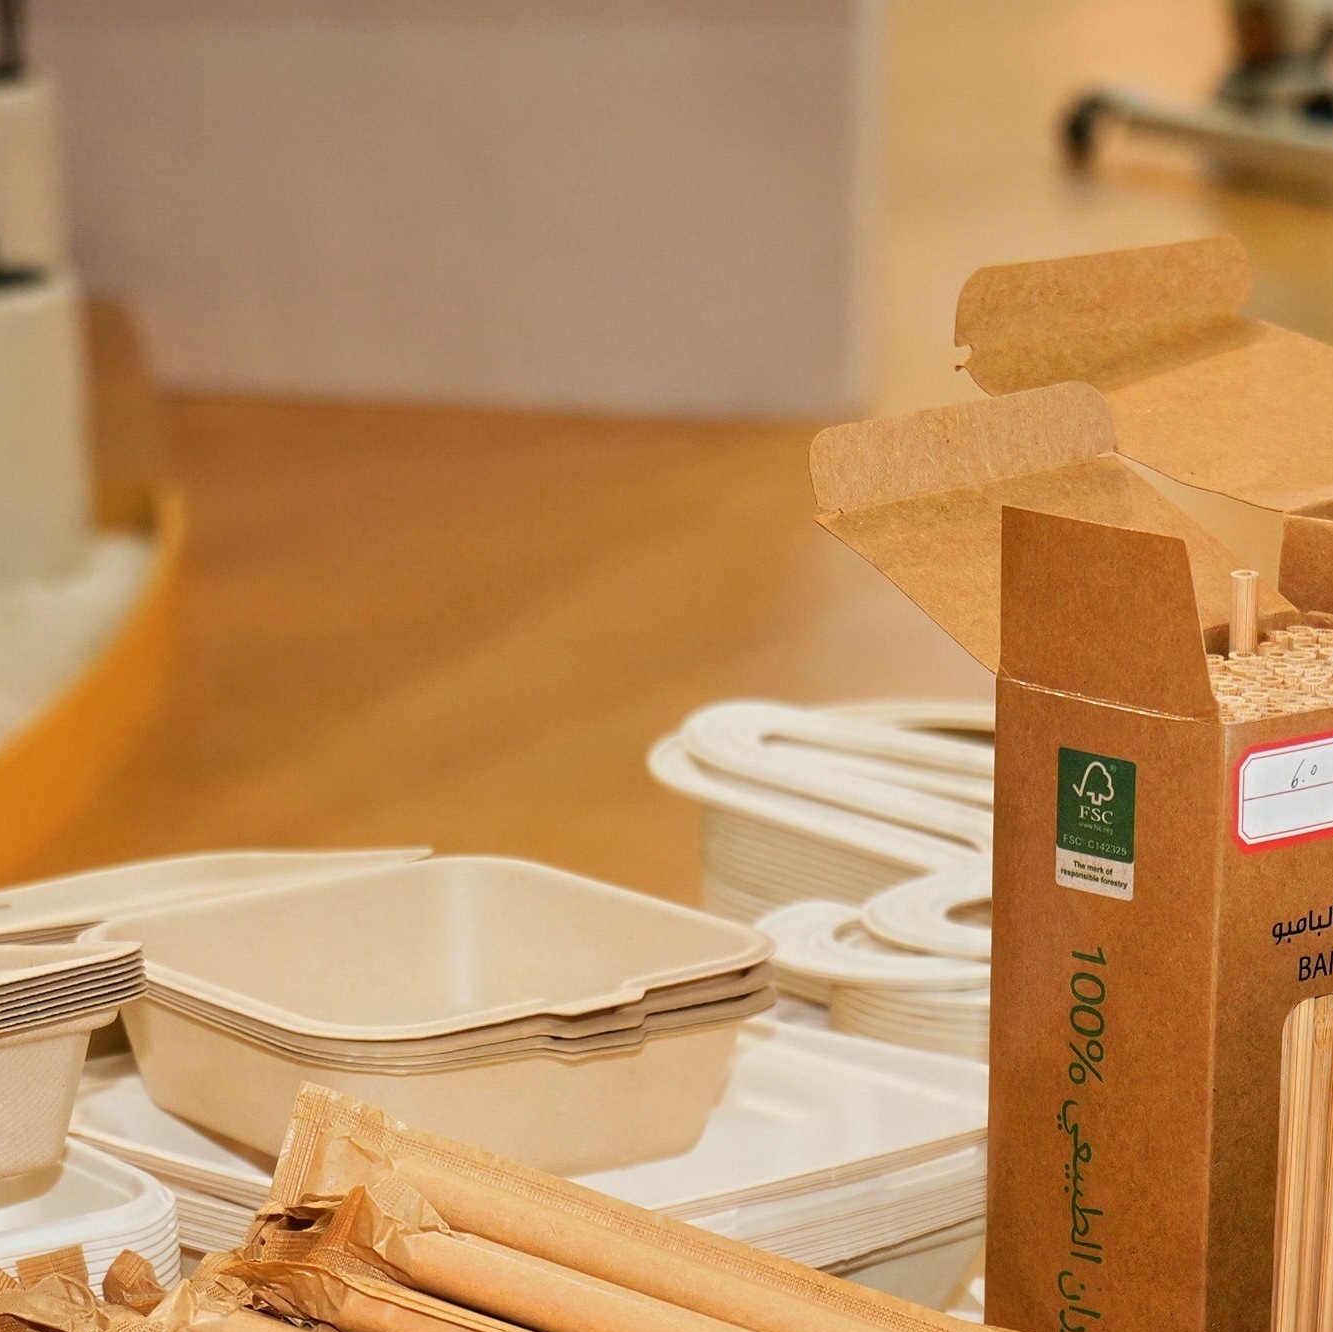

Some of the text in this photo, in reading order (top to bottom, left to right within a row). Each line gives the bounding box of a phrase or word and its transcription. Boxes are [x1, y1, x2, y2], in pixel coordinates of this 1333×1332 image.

[1079, 805, 1114, 825] FSC
[1088, 840, 1127, 856] C142325
[1060, 868, 1128, 890] responsible forestry
[1073, 860, 1114, 877] The mark of
[1068, 946, 1107, 1085] 100%
[1056, 1099, 1104, 1265] الطبيعي
